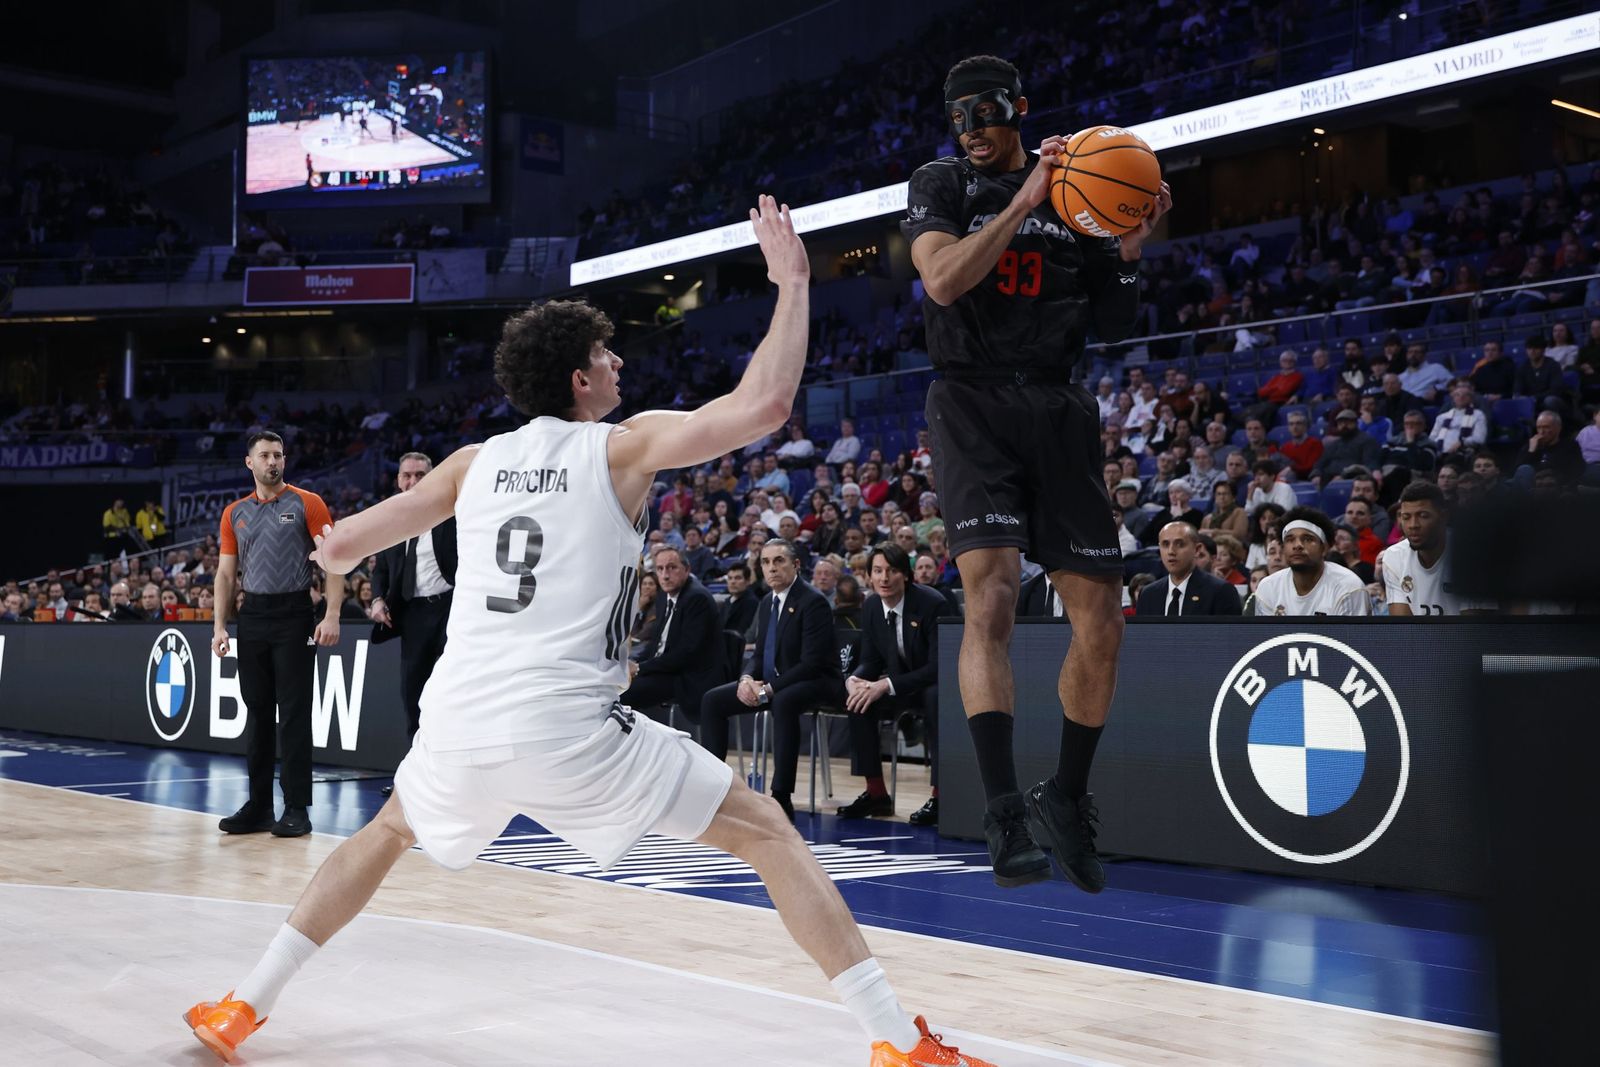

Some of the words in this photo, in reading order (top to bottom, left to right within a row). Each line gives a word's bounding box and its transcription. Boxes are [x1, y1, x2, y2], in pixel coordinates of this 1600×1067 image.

[1433, 49, 1503, 75] MADRID
[249, 110, 277, 123] BMW
[1117, 203, 1141, 218] acb
[305, 275, 353, 288] Mahou
[997, 250, 1042, 297] 93
[0, 440, 108, 467] MADRID
[494, 468, 568, 493] PROCIDA
[956, 517, 978, 530] vive
[486, 516, 544, 613] 9
[153, 635, 190, 665] BMW
[1233, 647, 1379, 709] BMW
[209, 637, 369, 751] BW
